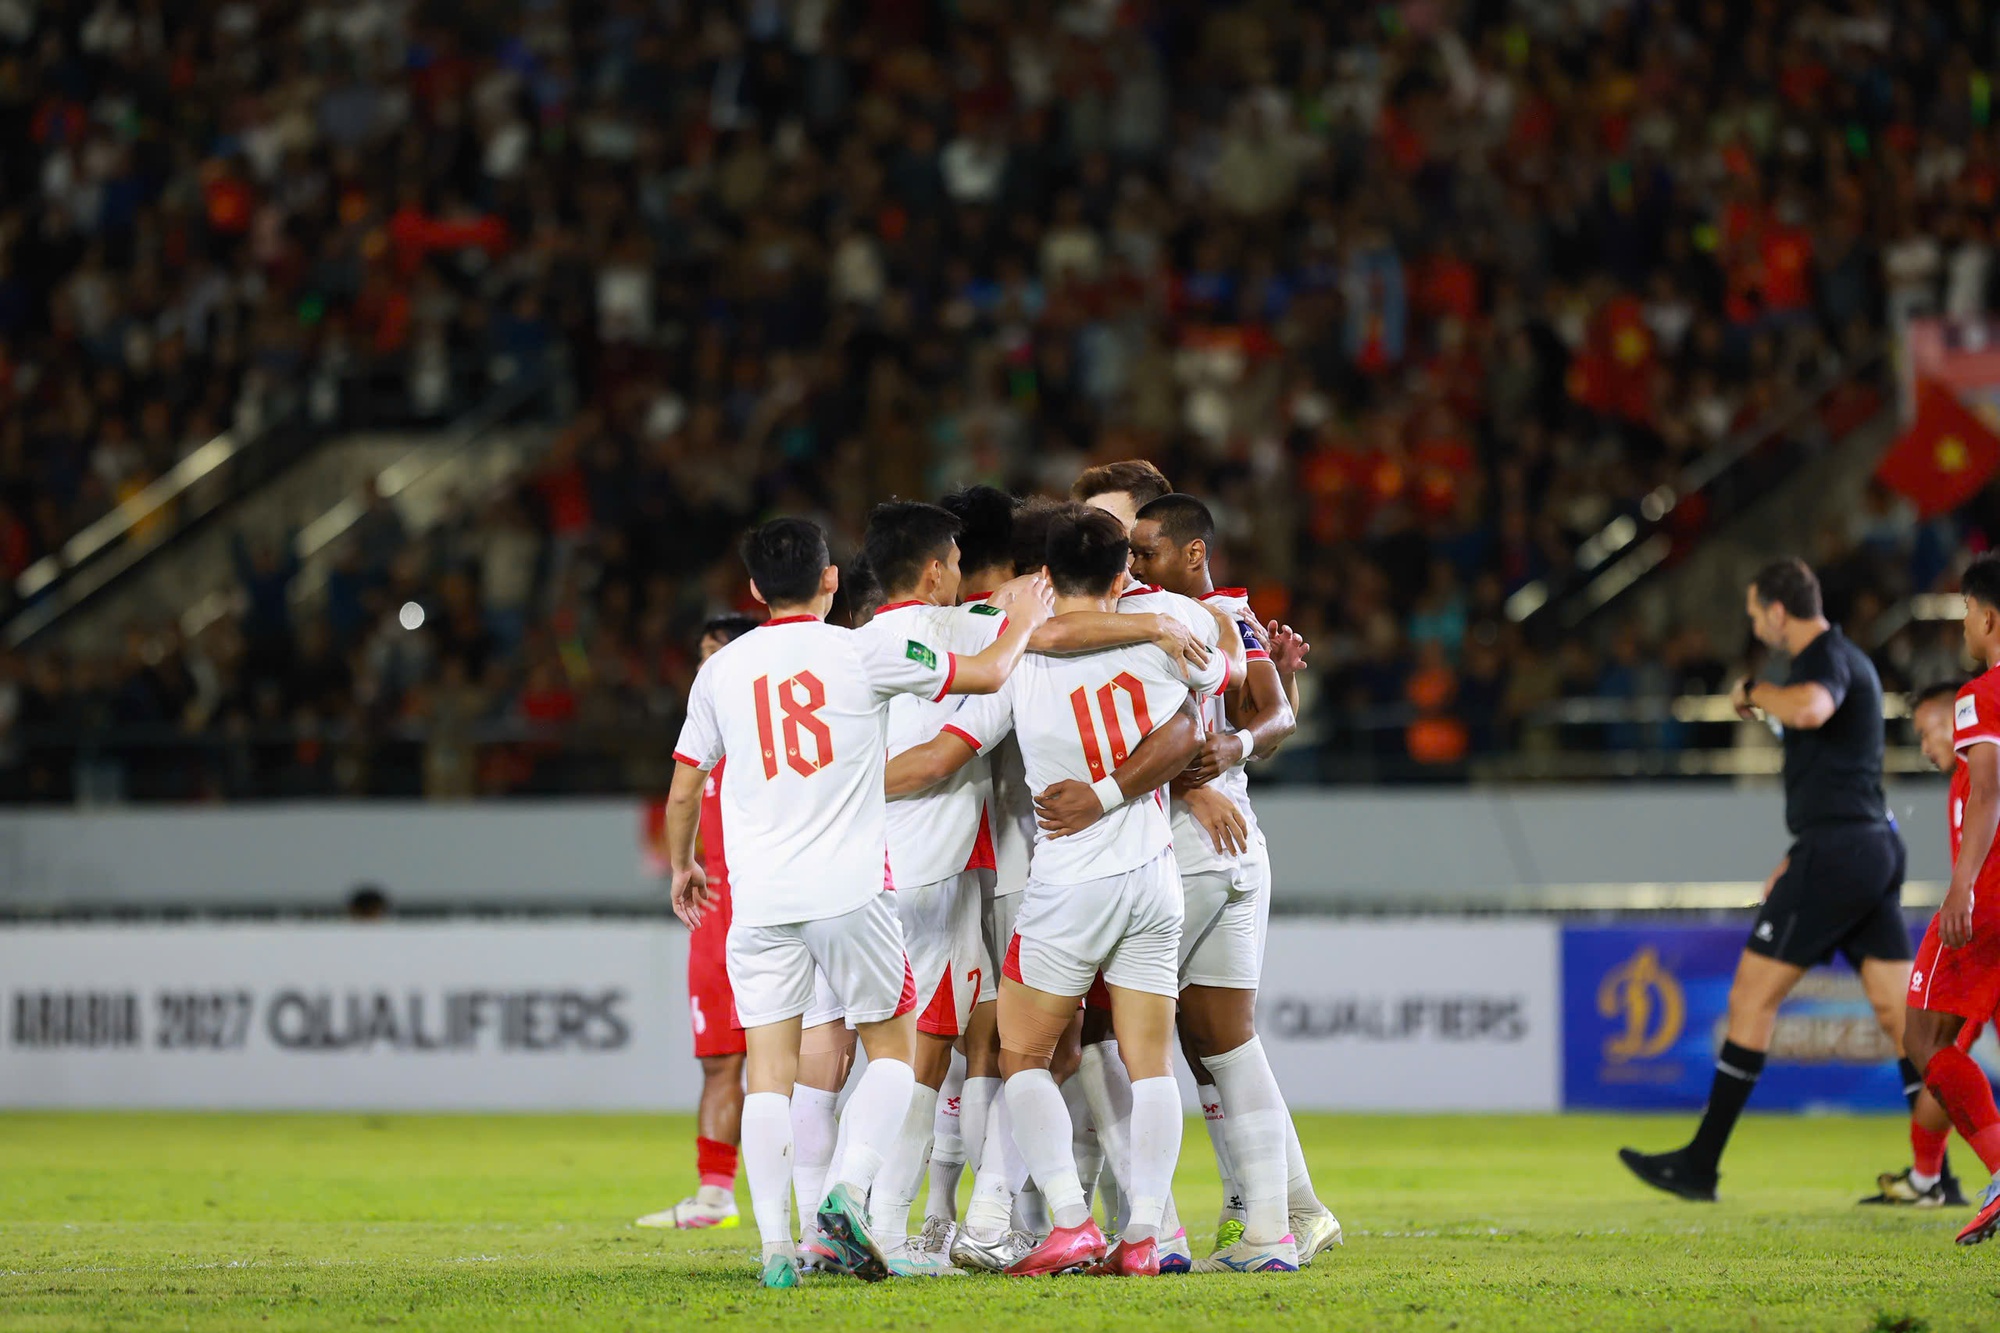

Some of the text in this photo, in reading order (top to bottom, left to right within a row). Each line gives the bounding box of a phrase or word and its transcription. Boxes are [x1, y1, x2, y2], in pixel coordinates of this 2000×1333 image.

[753, 669, 834, 781] 18
[1069, 670, 1154, 784] 10
[265, 988, 631, 1051] QUALIFIERS
[1269, 996, 1528, 1041] QUALIFIERS
